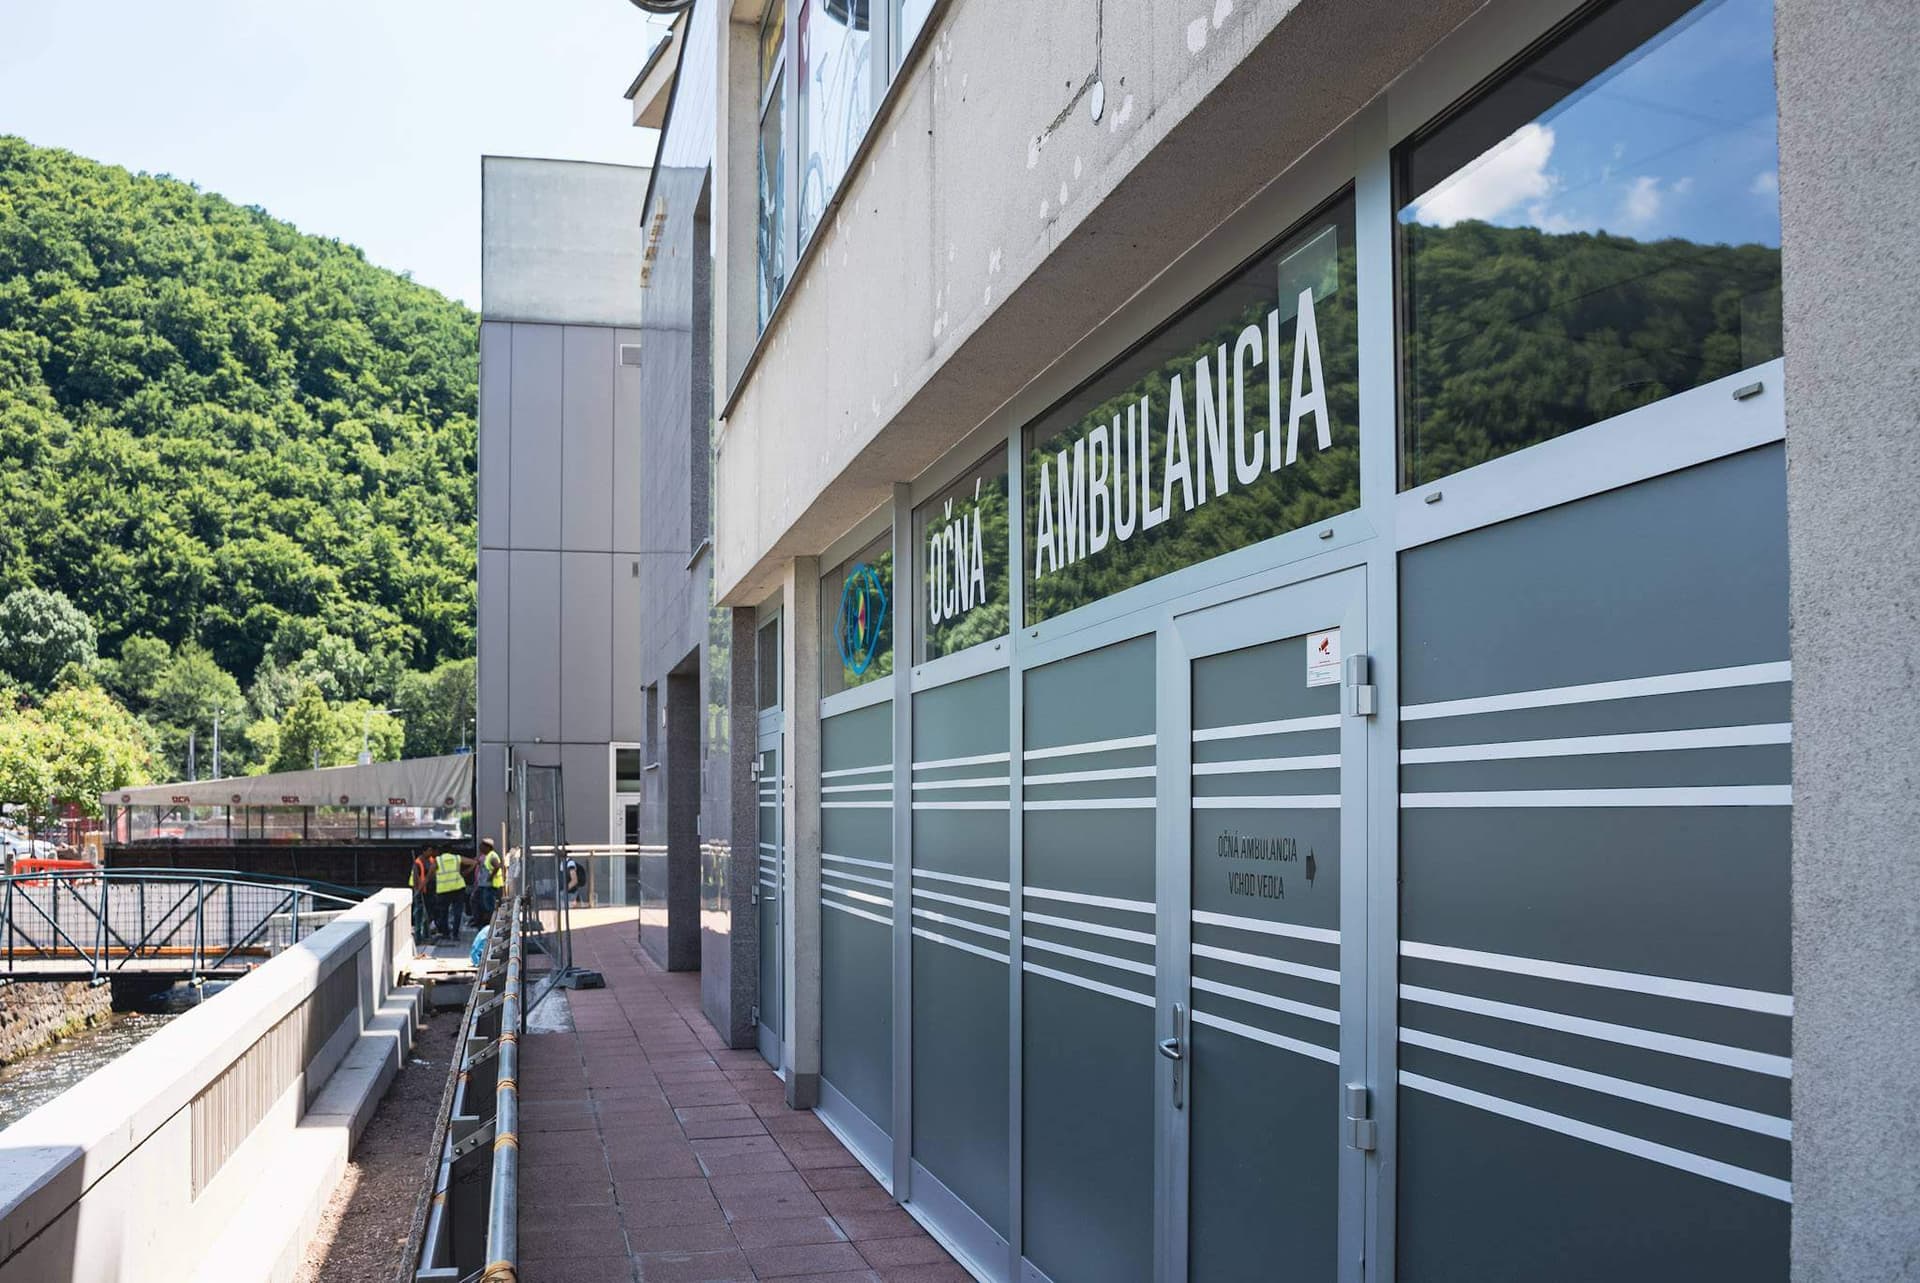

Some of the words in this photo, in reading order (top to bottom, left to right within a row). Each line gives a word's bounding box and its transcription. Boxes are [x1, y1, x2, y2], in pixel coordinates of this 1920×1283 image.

[930, 476, 986, 626] OČNÁ
[1034, 287, 1333, 580] AMBULANCIA
[1217, 829, 1240, 858] OČNÁ
[1240, 836, 1298, 862] AMBULANCIA
[1228, 871, 1256, 897] VCHOD
